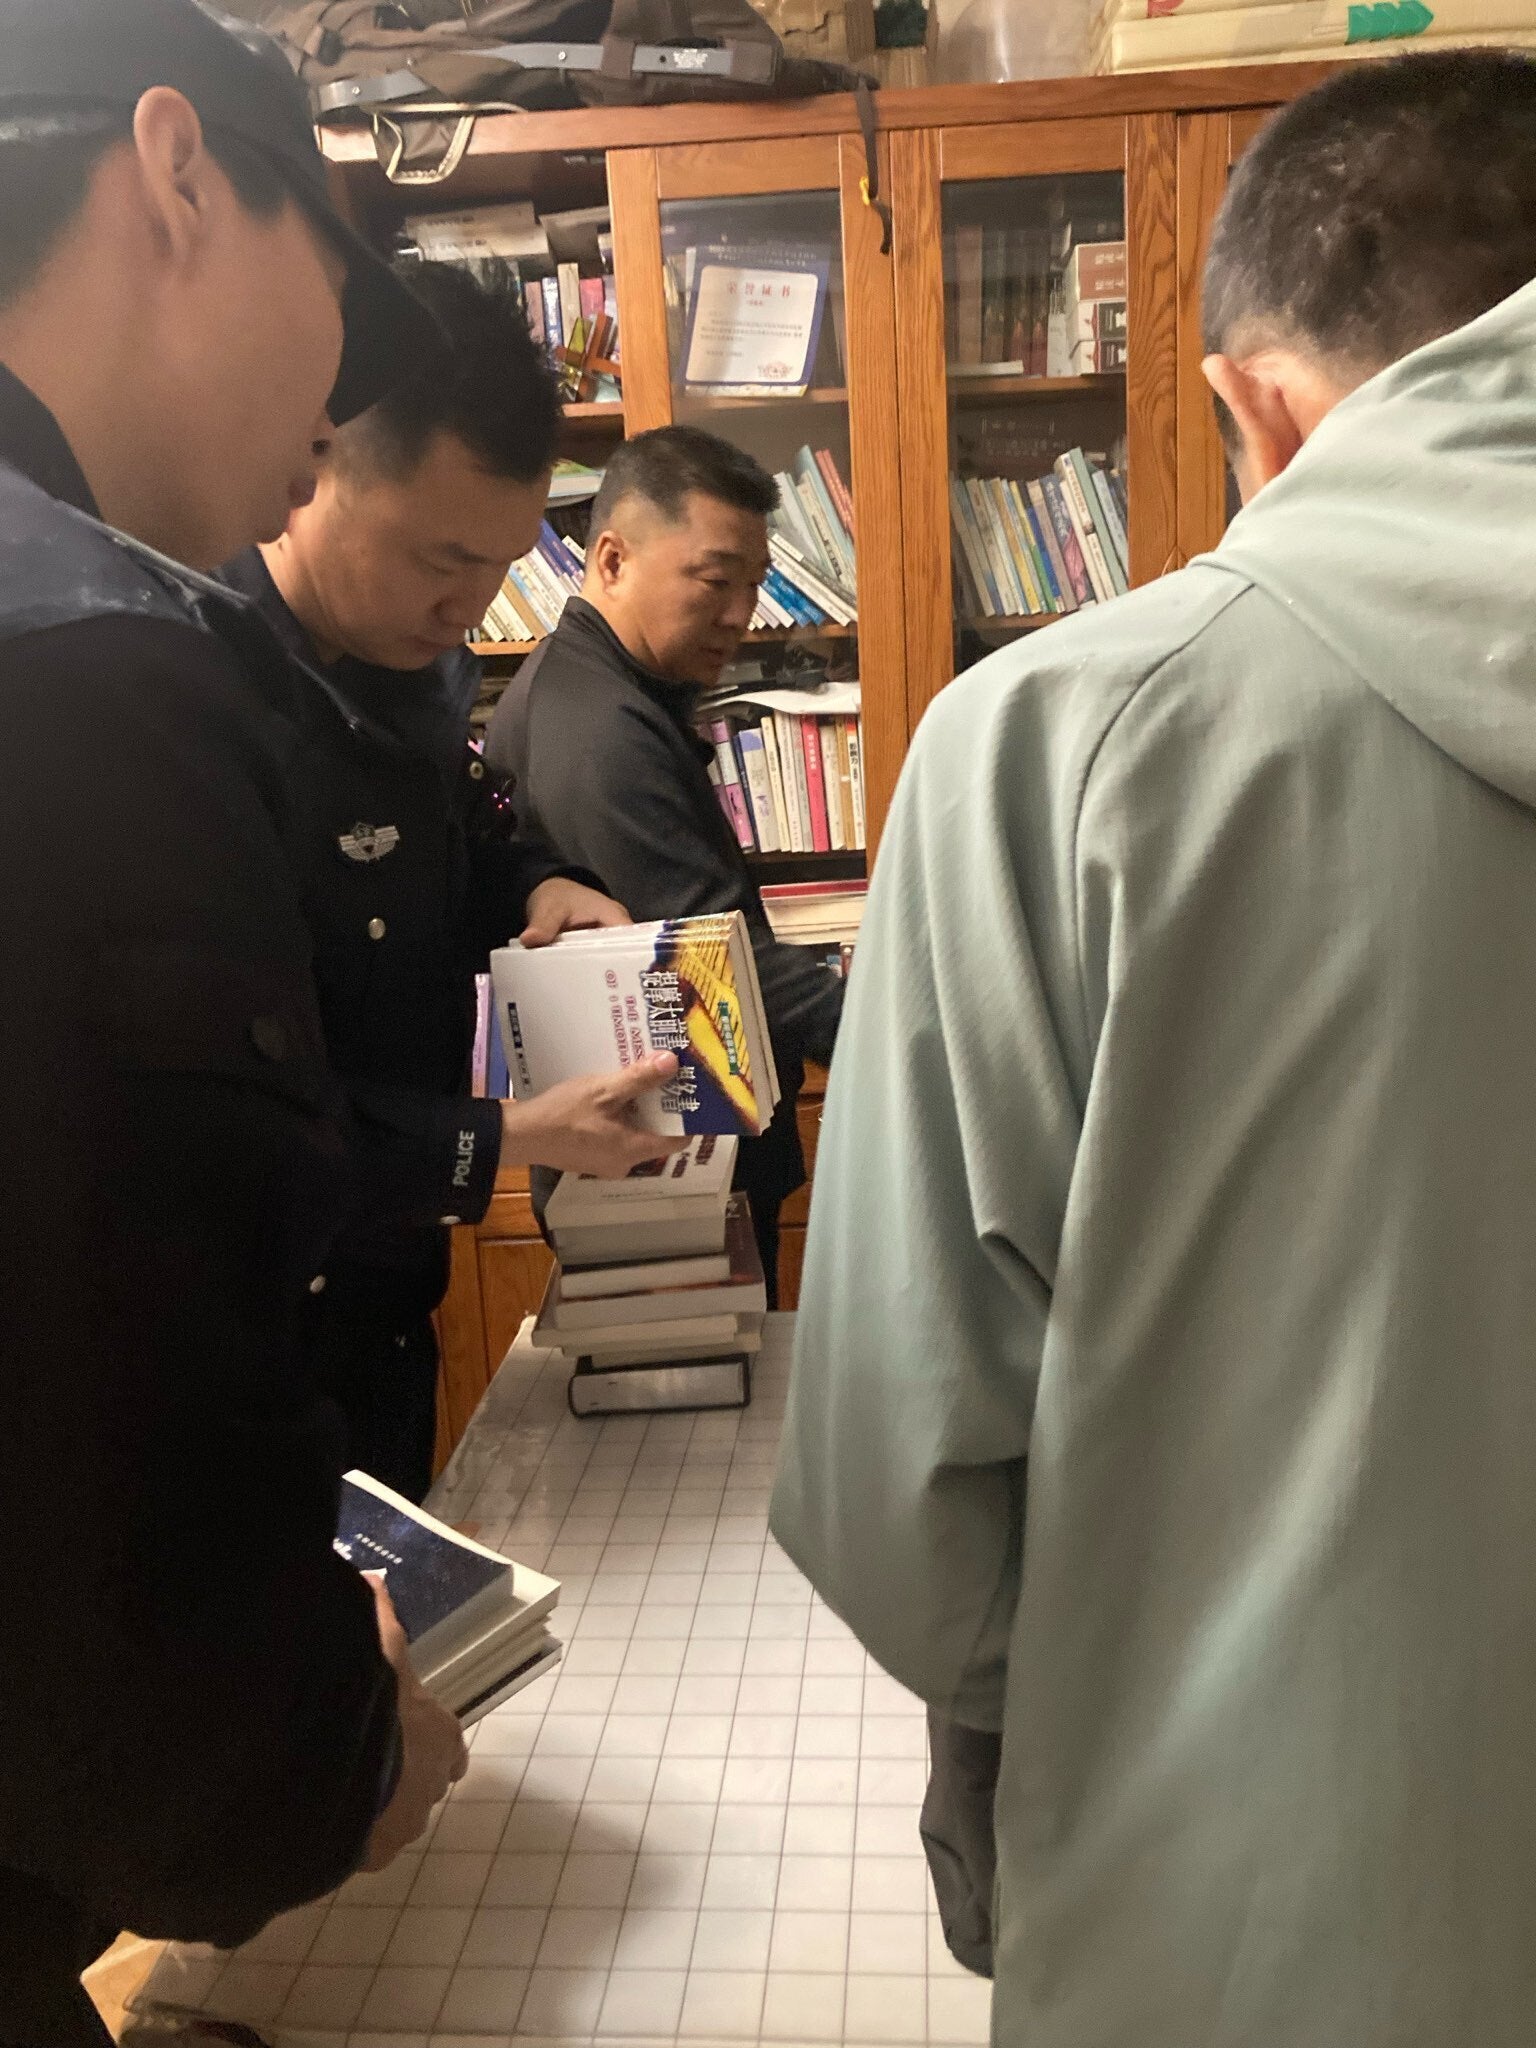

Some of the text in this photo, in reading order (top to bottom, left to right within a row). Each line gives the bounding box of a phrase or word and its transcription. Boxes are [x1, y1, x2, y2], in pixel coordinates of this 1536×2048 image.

[641, 970, 690, 1050] 提摩太前書
[453, 1129, 475, 1186] POLICE
